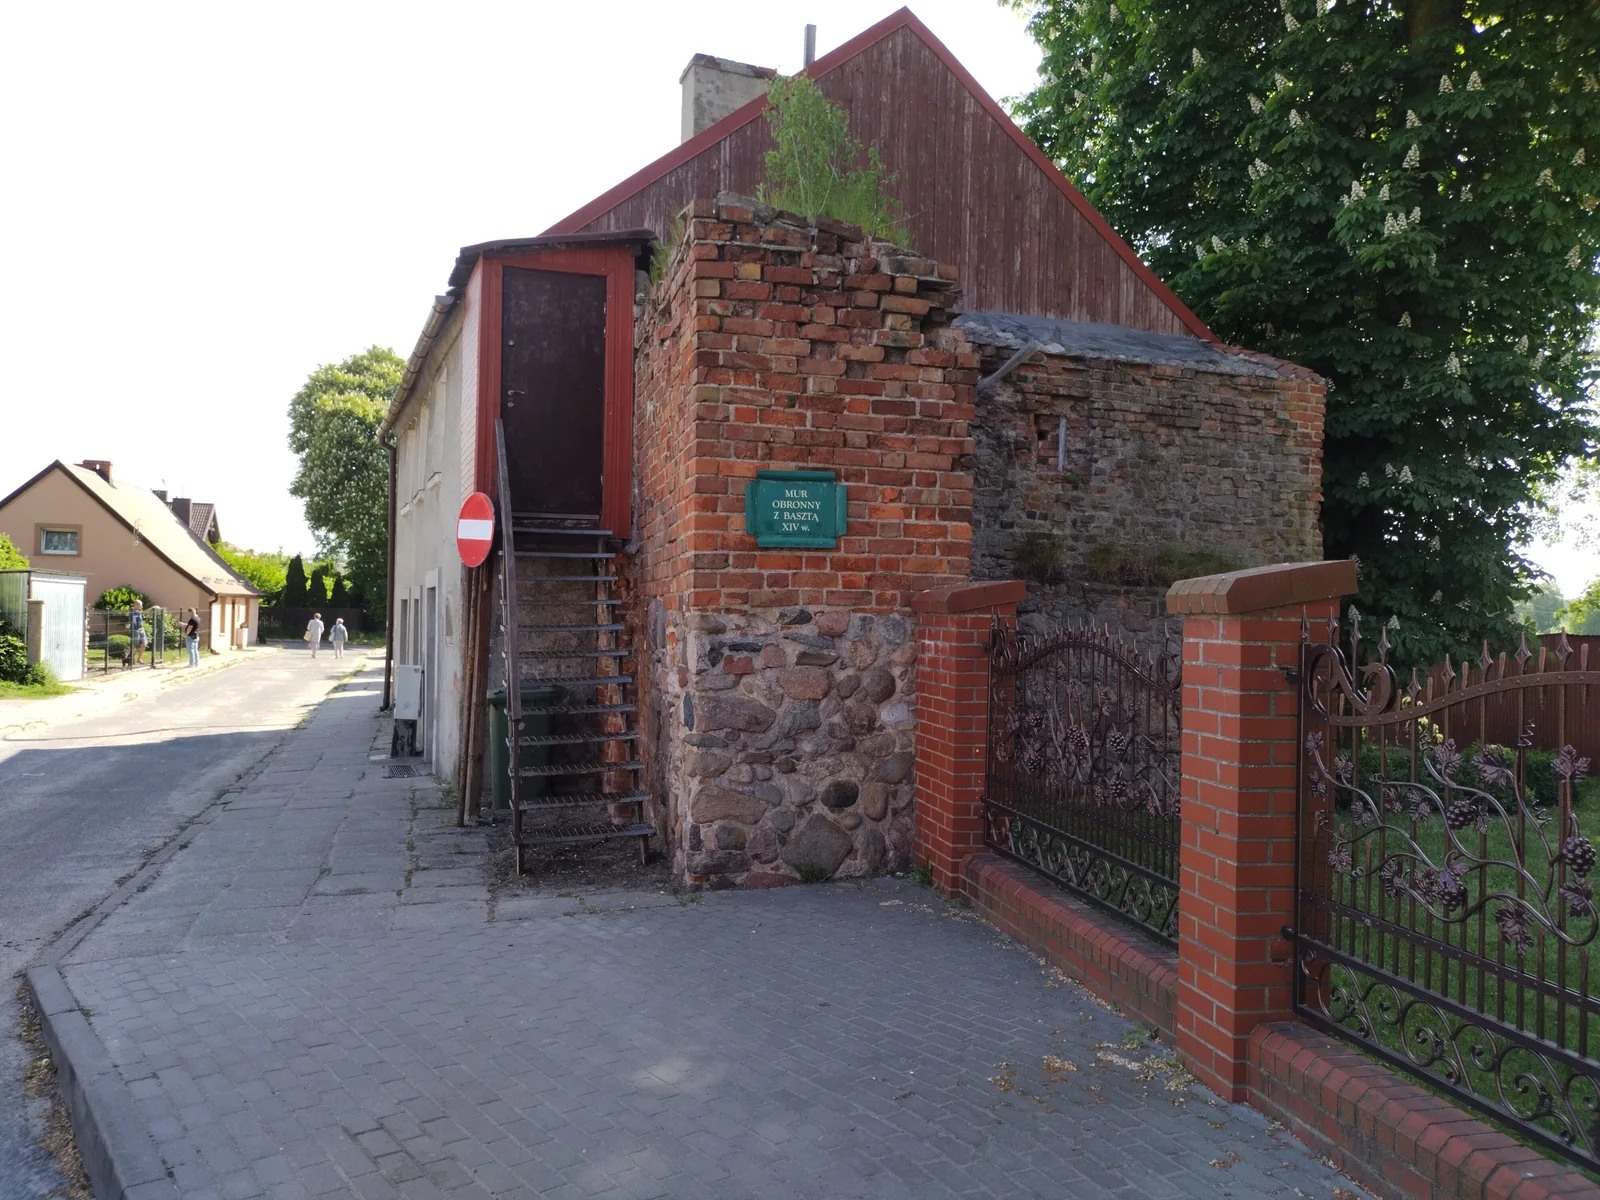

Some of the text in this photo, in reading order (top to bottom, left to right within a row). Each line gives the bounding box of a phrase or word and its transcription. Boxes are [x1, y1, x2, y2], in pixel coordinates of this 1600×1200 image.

[785, 489, 807, 498] MUR
[772, 500, 821, 509] OBRONNY
[773, 511, 819, 522] Z BASZTĄ
[782, 522, 799, 531] XIV
